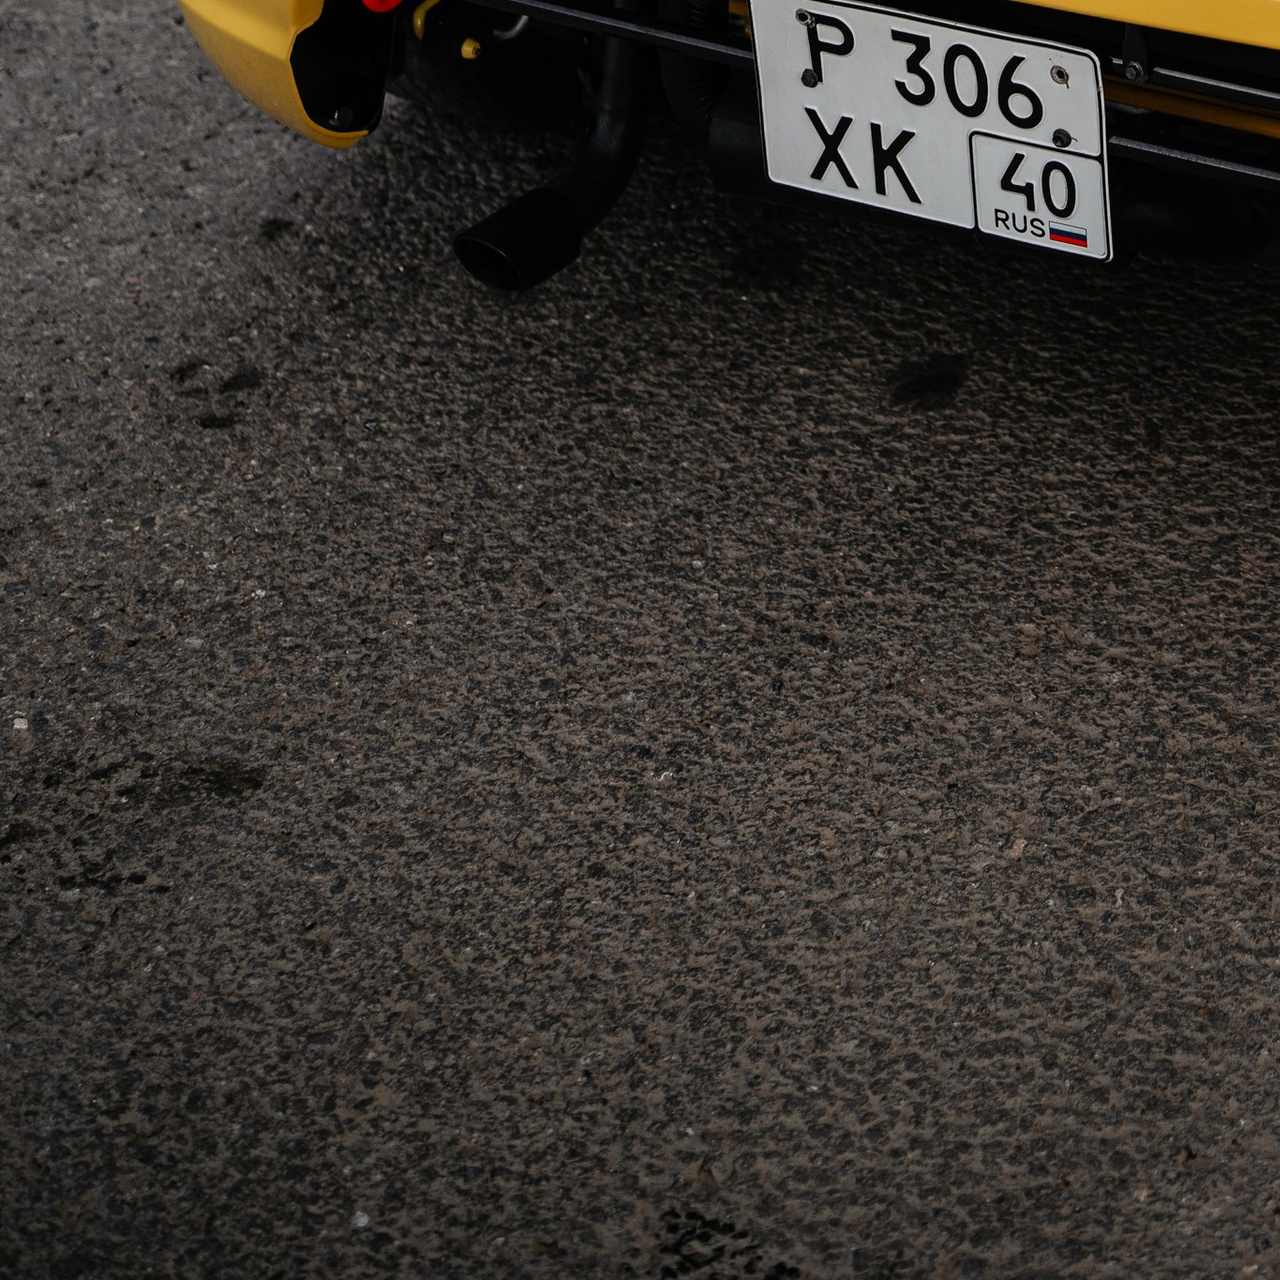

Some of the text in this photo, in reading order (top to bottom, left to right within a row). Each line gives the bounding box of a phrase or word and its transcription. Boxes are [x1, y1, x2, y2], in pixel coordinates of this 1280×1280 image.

[890, 29, 1044, 129] 306
[1000, 152, 1076, 219] 40
[994, 208, 1046, 238] RUS
